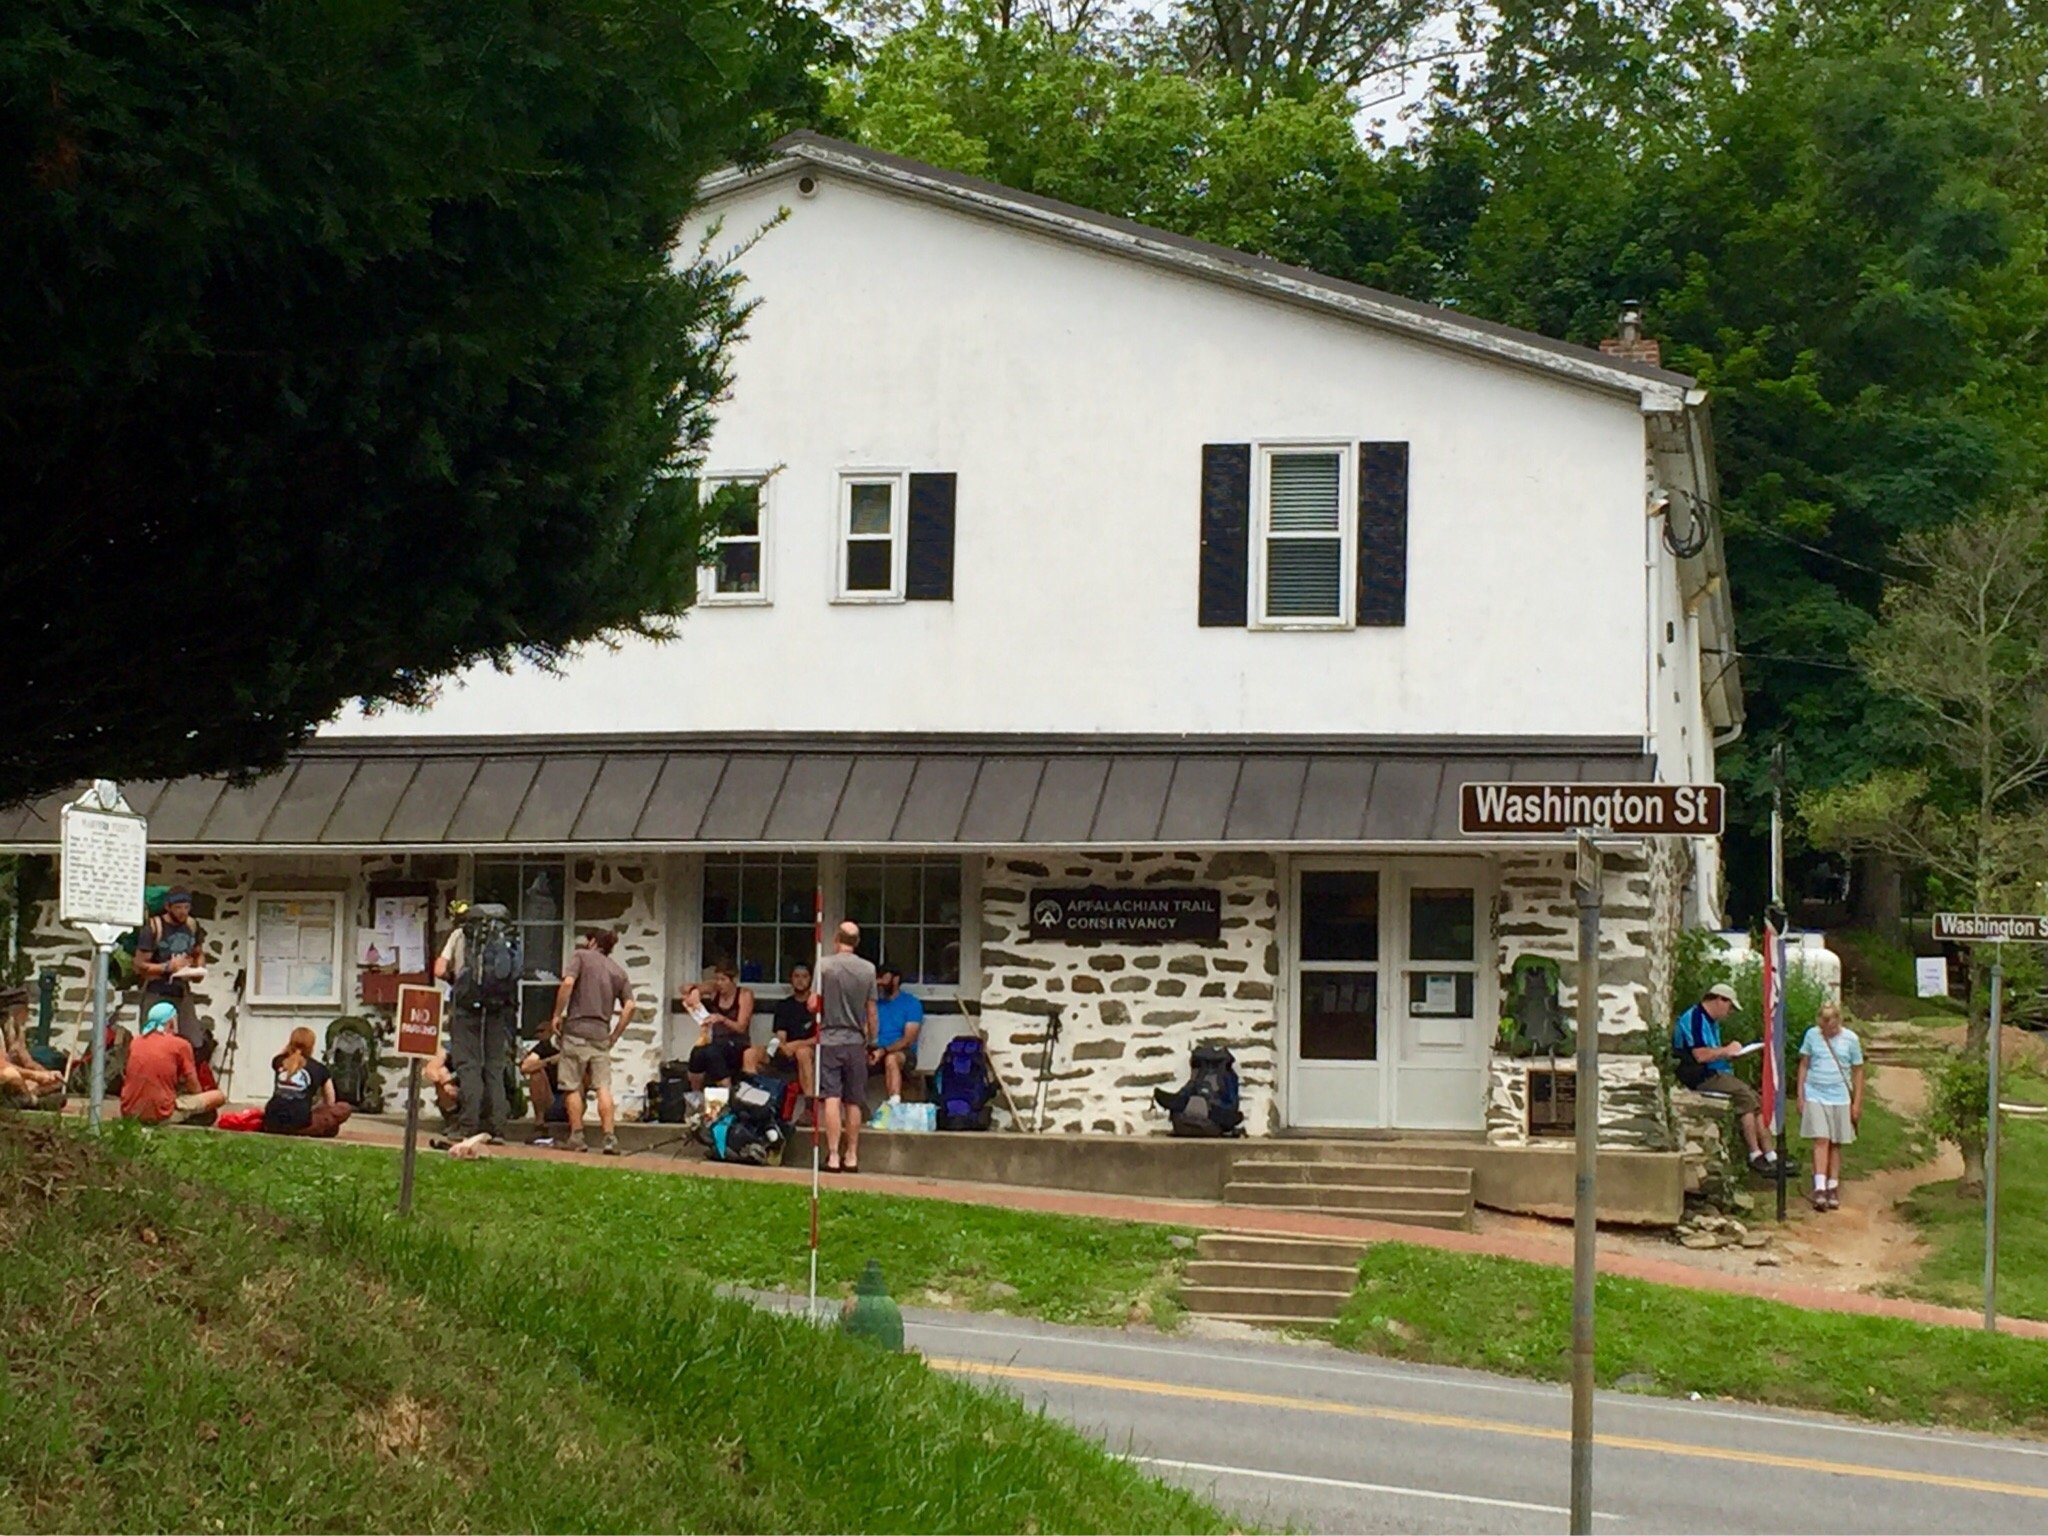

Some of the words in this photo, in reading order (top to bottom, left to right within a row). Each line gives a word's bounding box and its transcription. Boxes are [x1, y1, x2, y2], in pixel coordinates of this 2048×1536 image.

[1475, 786, 1664, 828] Washington
[1674, 787, 1709, 824] St
[1067, 901, 1168, 912] APPALACHIAN
[1175, 901, 1215, 912] TRAIL
[1067, 917, 1177, 929] CONSERVANCY
[1940, 914, 2035, 940] Washington
[2038, 917, 2048, 937] S
[410, 1008, 431, 1023] NO
